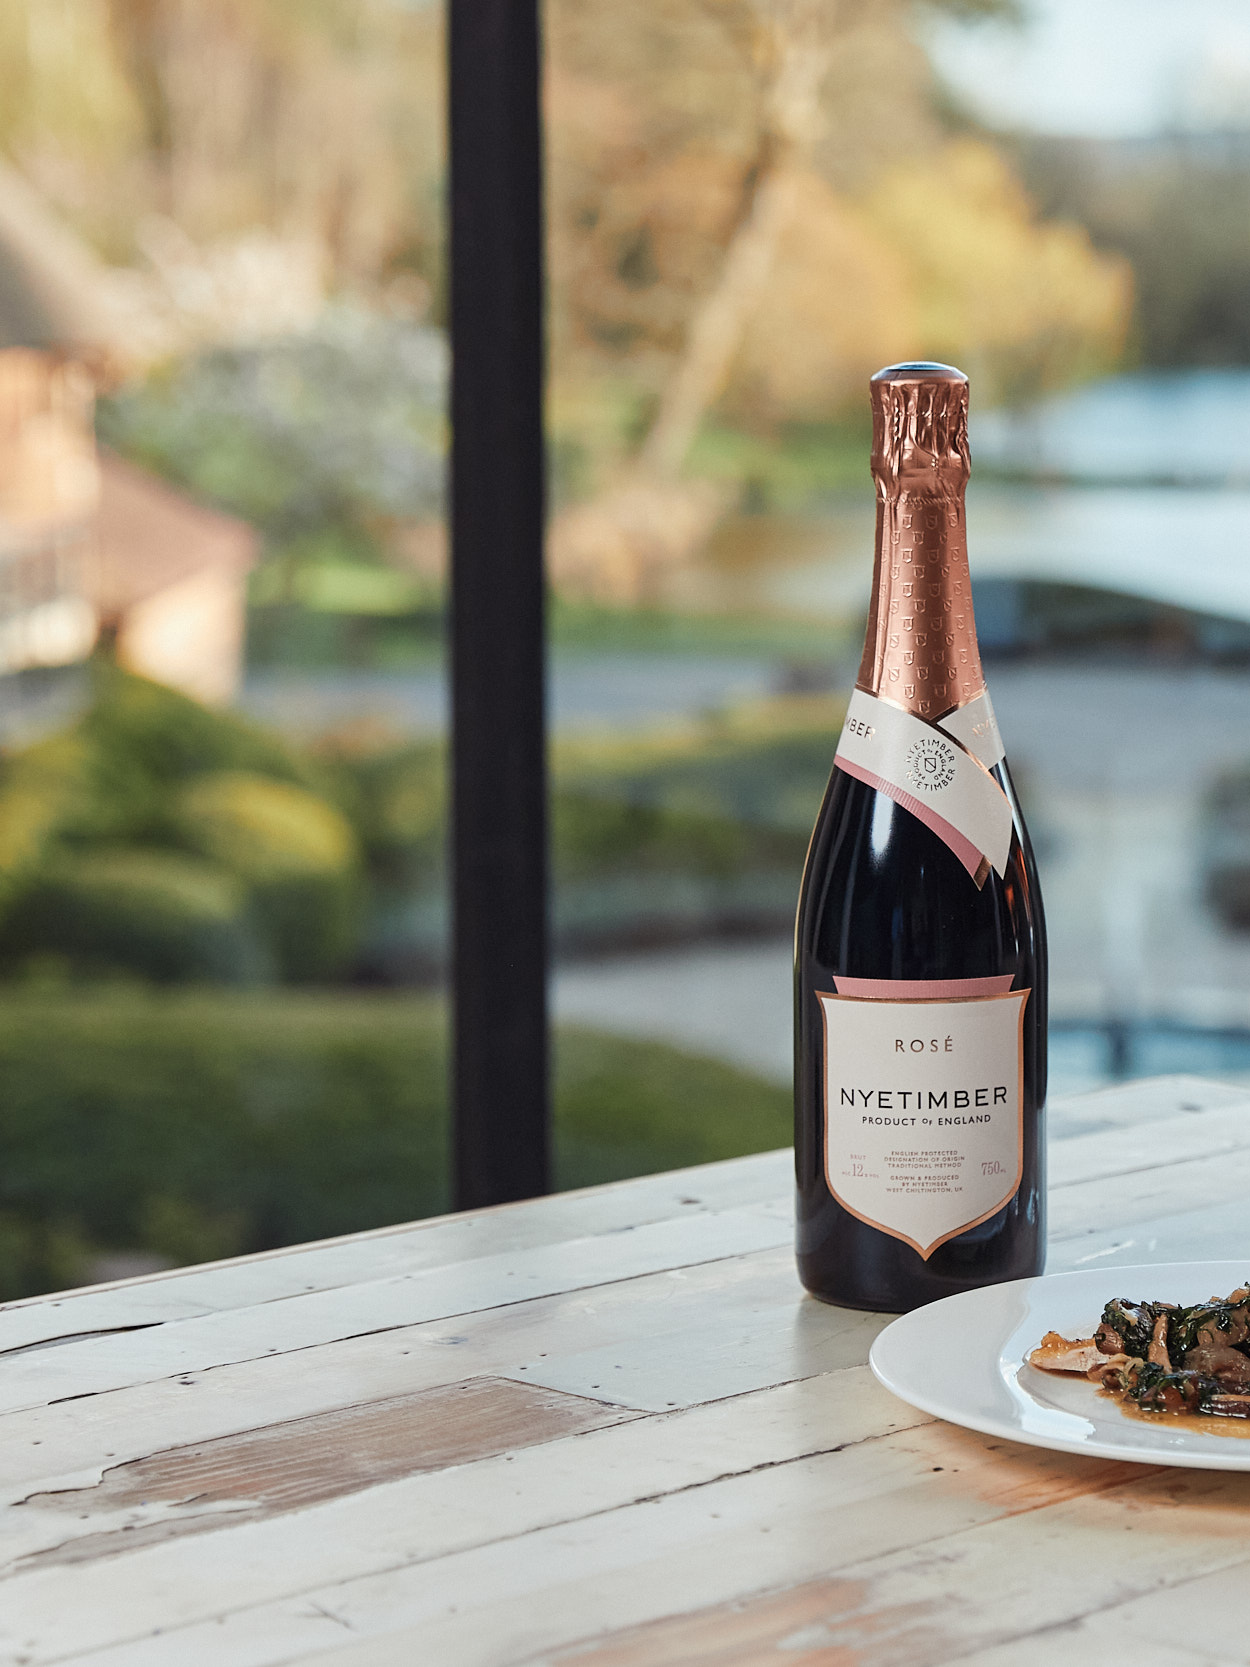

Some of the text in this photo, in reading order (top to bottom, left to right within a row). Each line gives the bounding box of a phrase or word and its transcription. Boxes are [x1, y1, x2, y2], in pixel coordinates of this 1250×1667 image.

[905, 739, 955, 763] NYETIMBER
[905, 768, 956, 791] NYETIMBER
[895, 1035, 953, 1053] ROSÉ
[840, 1086, 1008, 1110] NYETIMBER
[862, 1116, 917, 1126] PRODUCT
[938, 1114, 991, 1126] ENGLAND
[852, 1163, 864, 1177] 12
